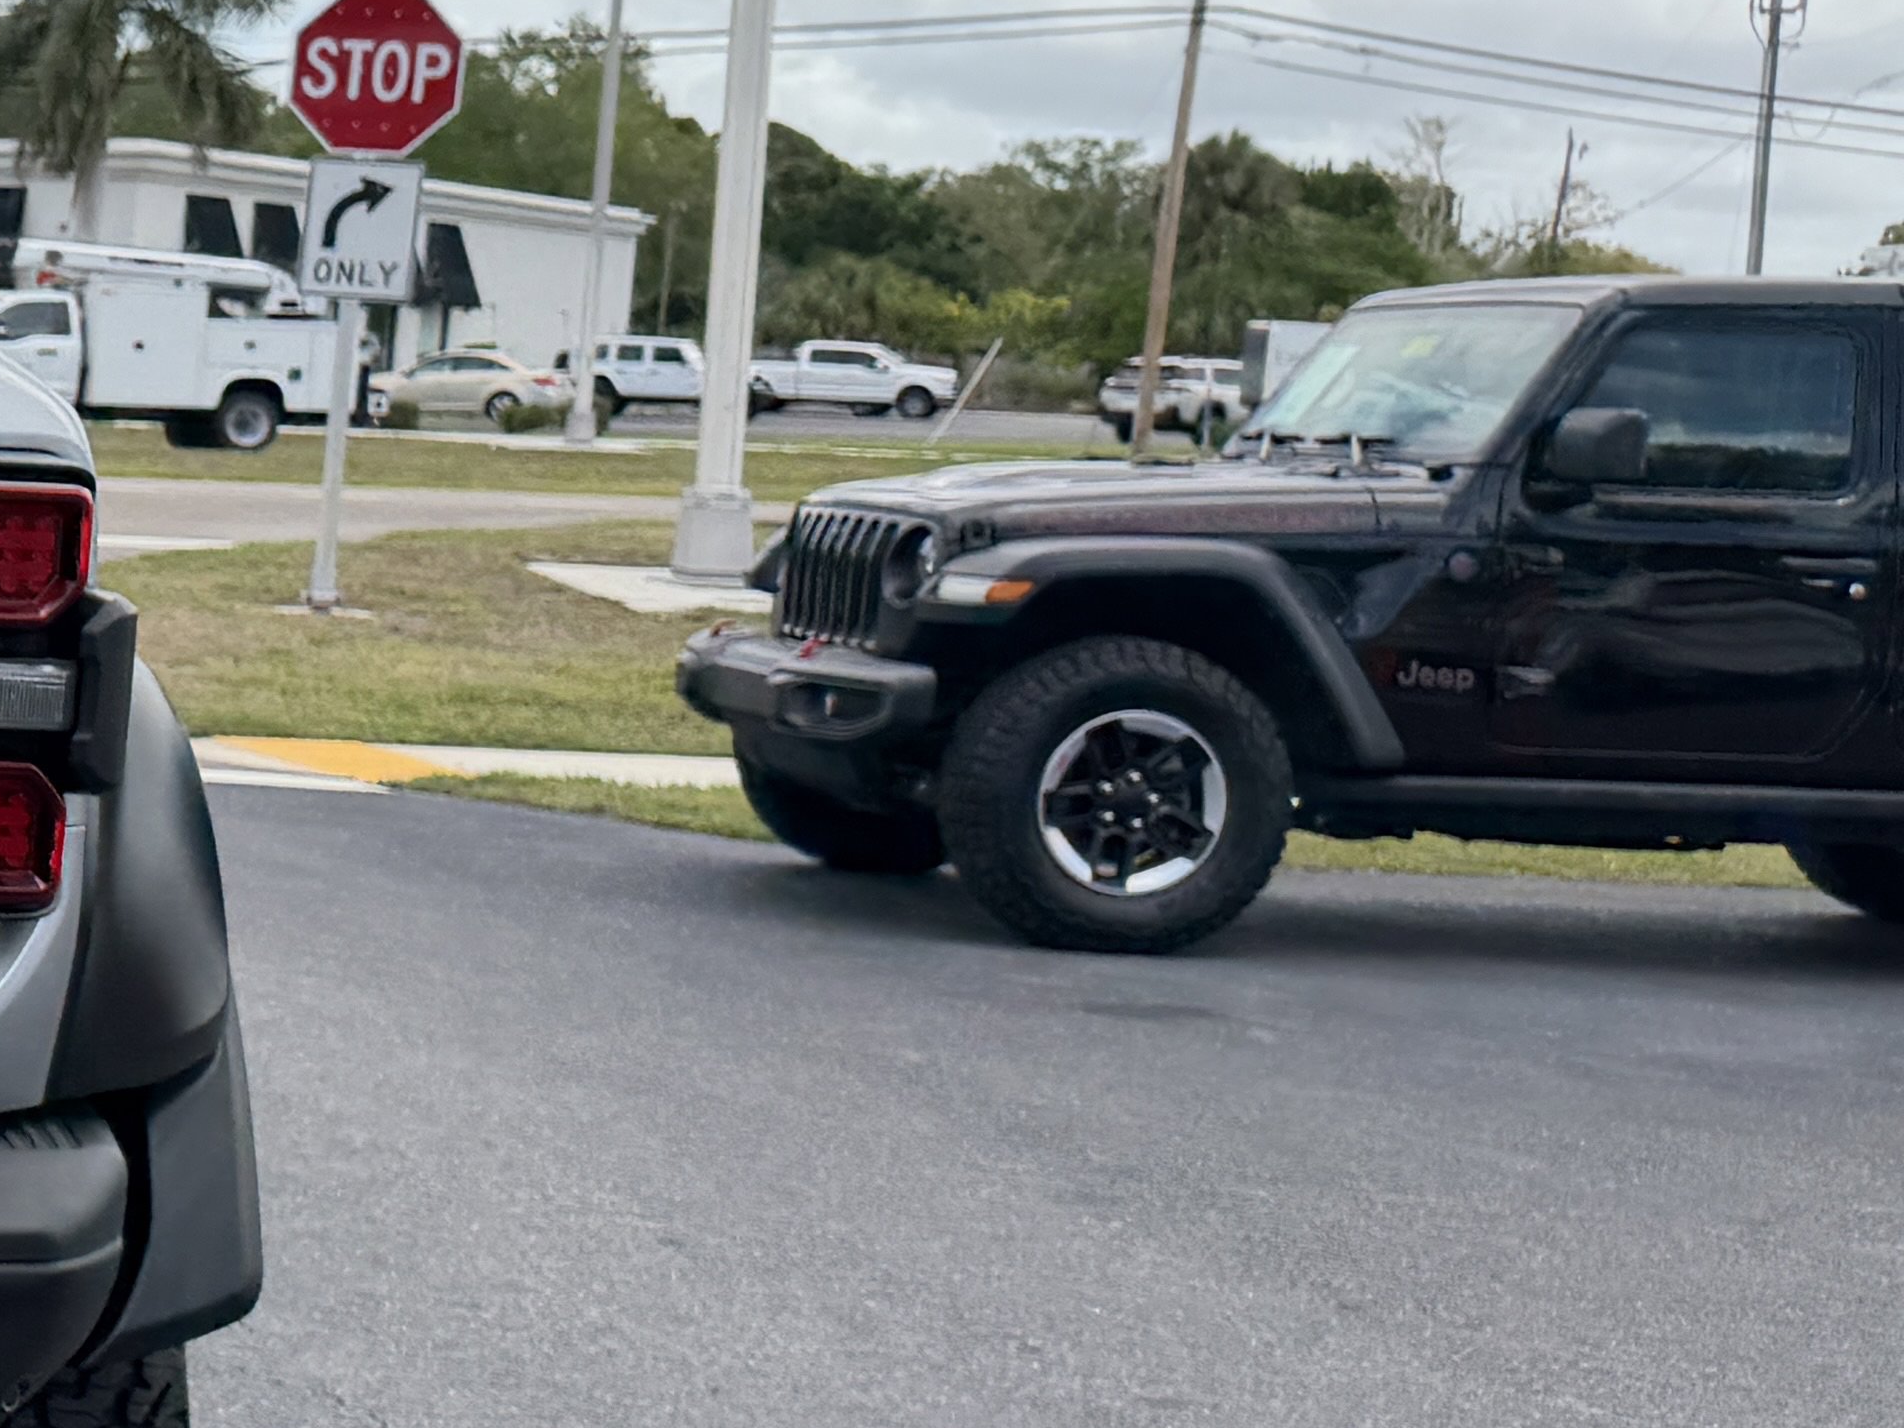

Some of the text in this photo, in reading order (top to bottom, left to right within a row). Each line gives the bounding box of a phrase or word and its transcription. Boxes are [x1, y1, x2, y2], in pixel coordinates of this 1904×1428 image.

[300, 36, 452, 105] STOP
[314, 257, 398, 289] ONLY
[1396, 658, 1476, 694] Jeep
